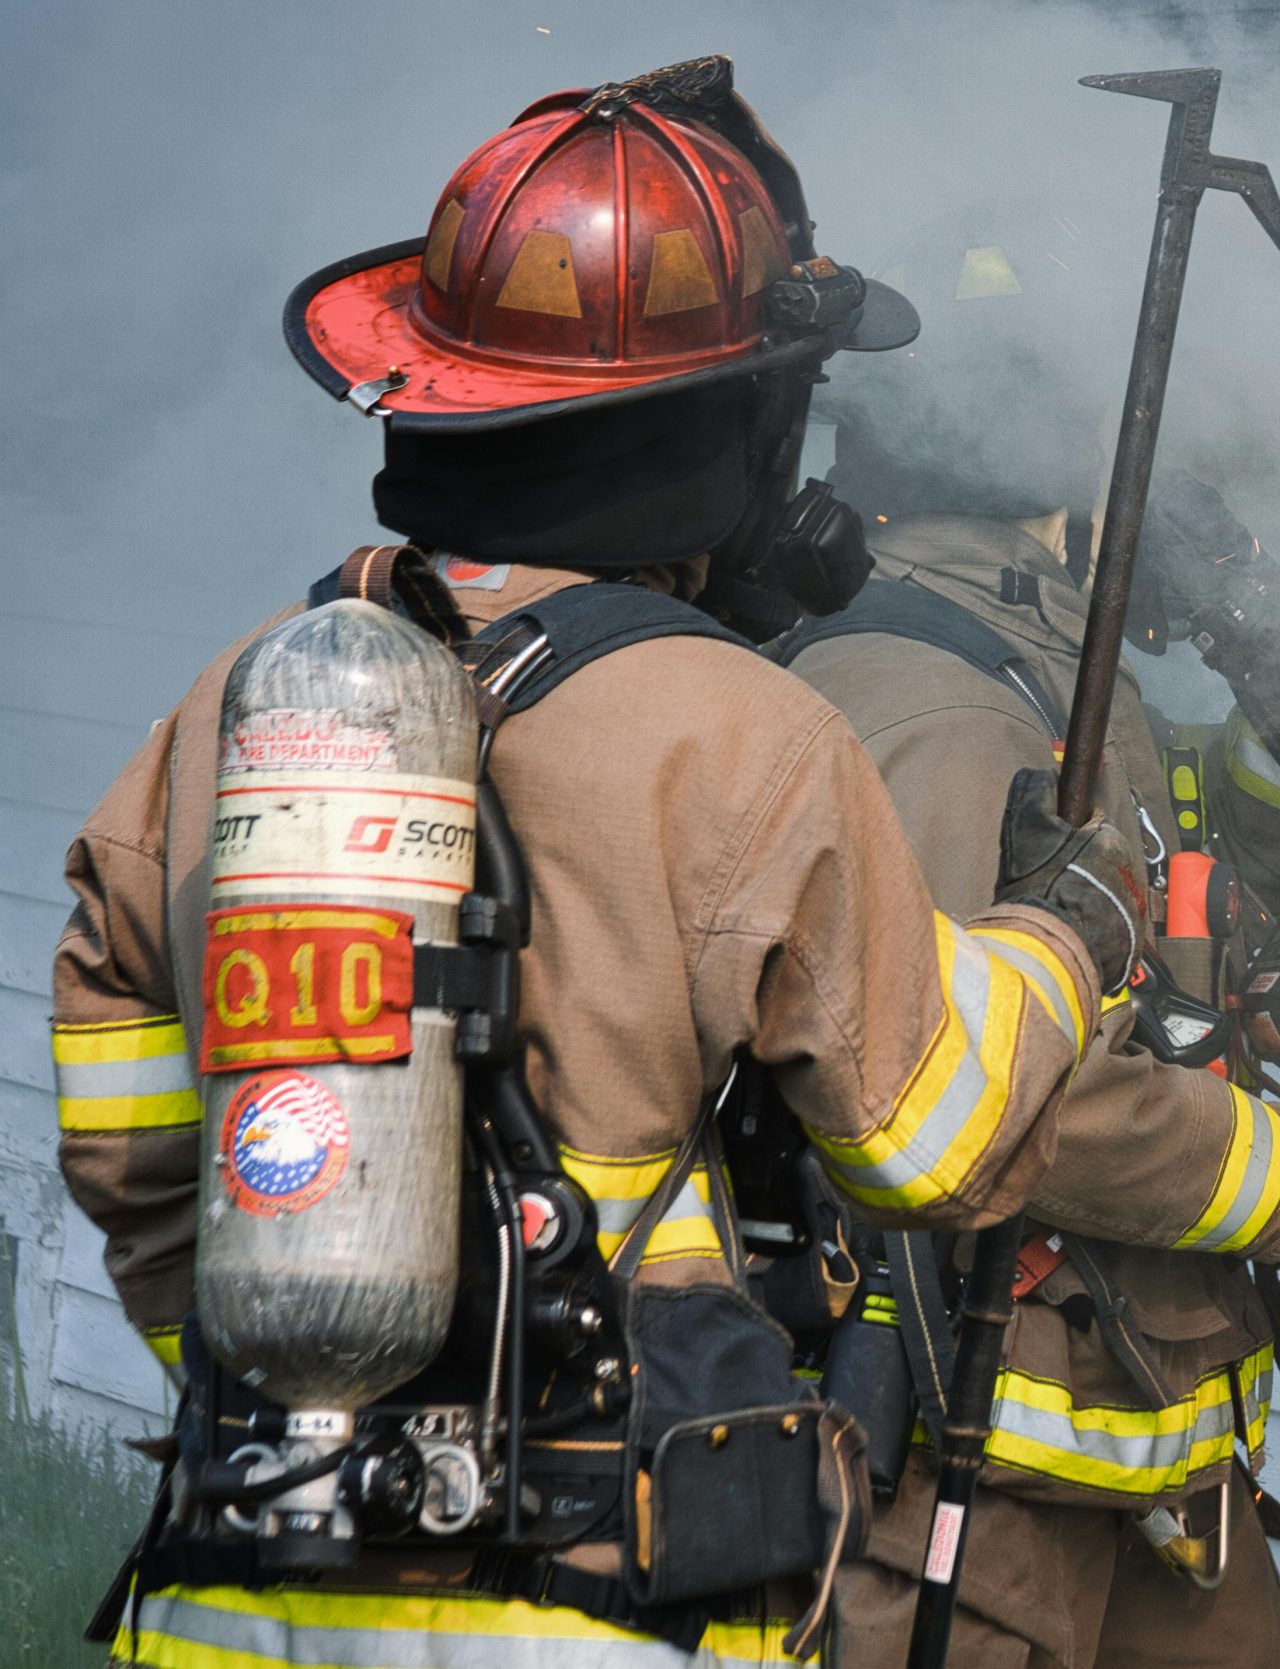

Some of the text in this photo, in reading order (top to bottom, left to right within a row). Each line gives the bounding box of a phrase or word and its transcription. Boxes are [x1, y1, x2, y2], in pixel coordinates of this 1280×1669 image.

[269, 743, 381, 762] DEPARTMENT
[402, 819, 475, 853] SCOTT
[214, 942, 383, 1029] Q10
